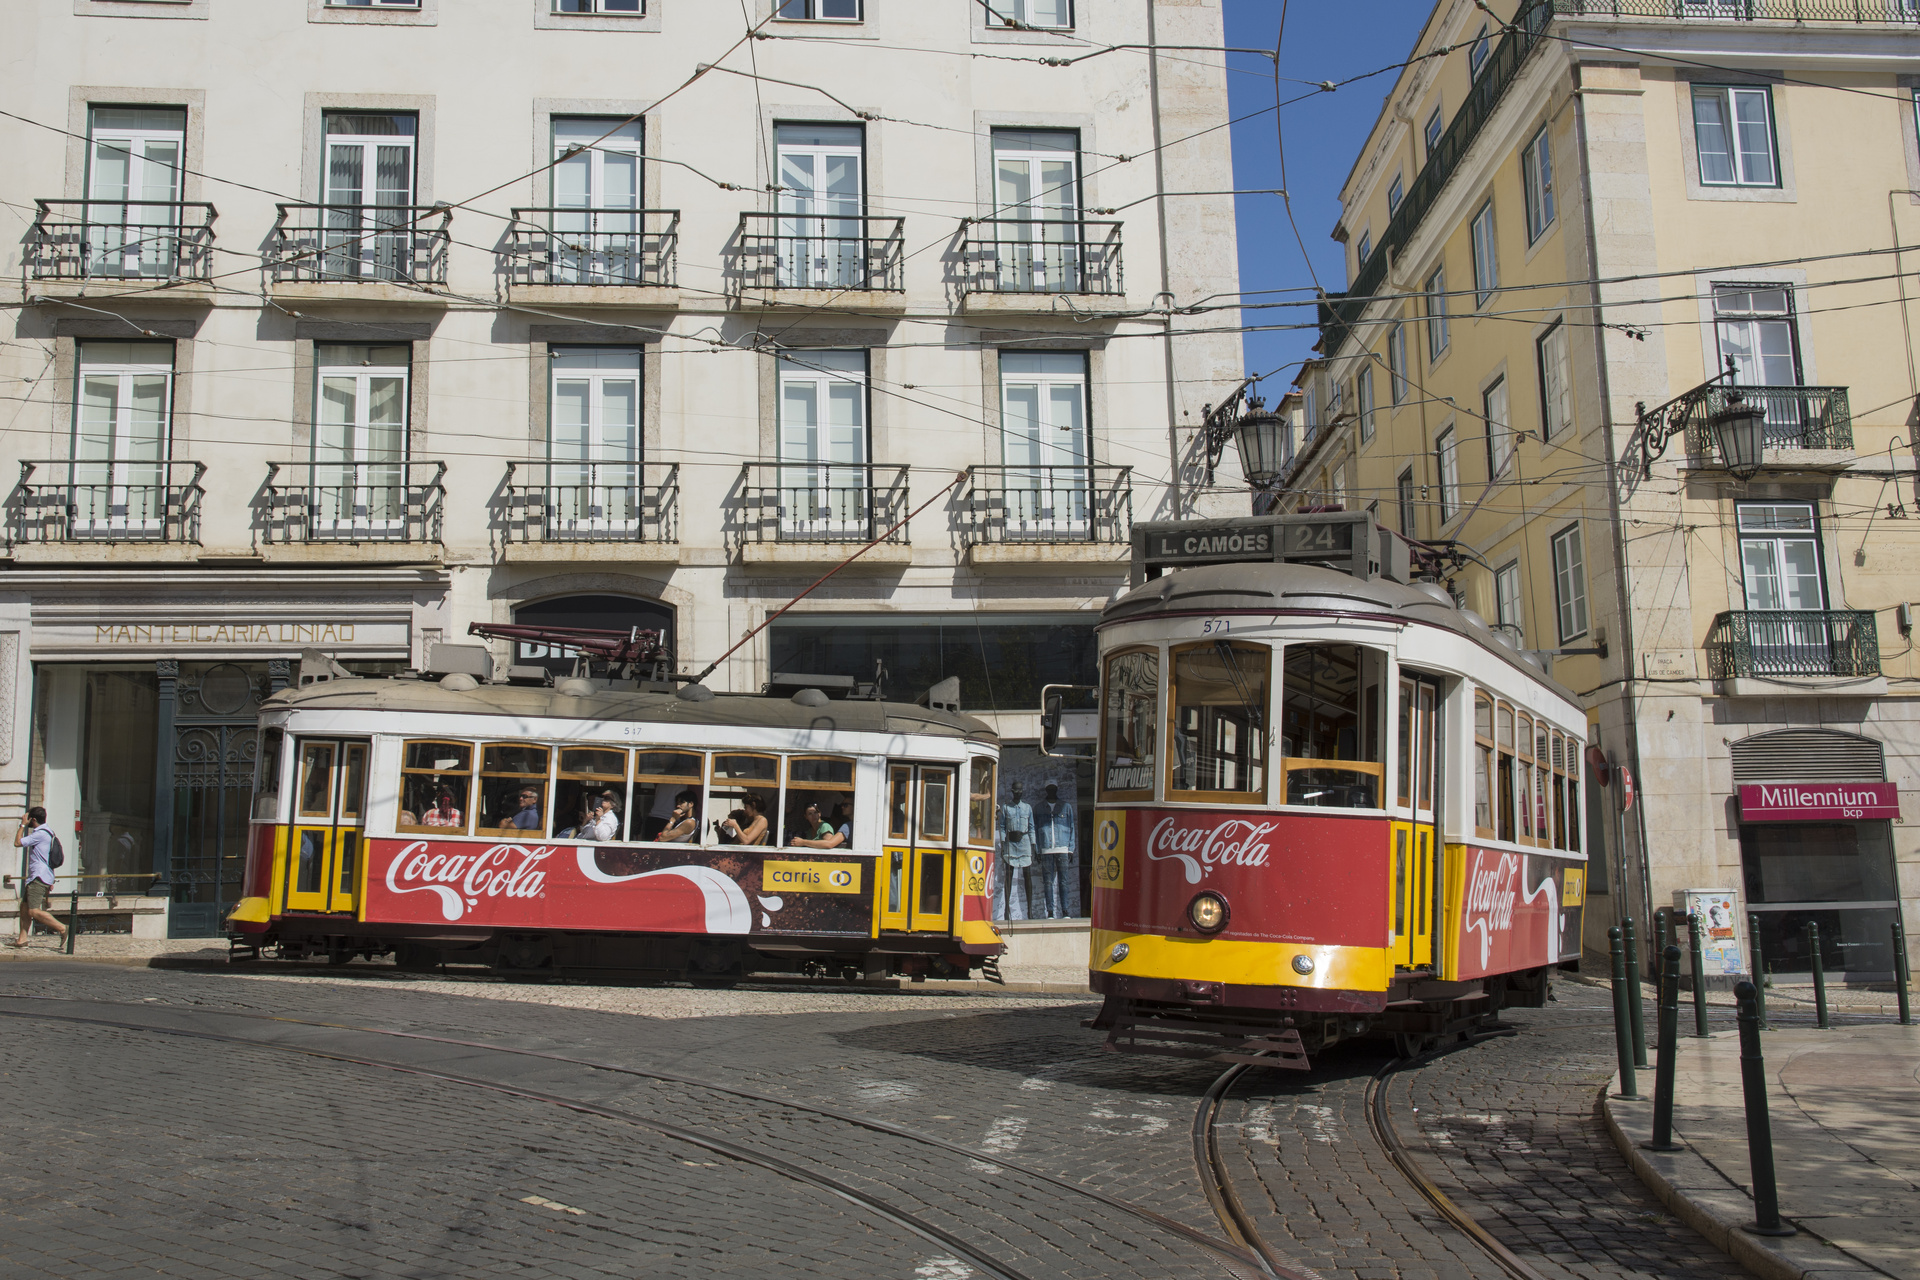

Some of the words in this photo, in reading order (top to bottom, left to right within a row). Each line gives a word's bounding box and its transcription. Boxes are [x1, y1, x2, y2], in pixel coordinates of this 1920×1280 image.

[1161, 538, 1177, 554] L.
[1295, 525, 1336, 551] 24
[95, 624, 272, 643] MANTEIGARIA
[1203, 620, 1231, 633] 571
[1759, 784, 1878, 807] Millennium
[1843, 807, 1863, 819] bcp
[1147, 817, 1279, 873] Coca-Cola
[386, 841, 557, 908] Coca-Cola
[772, 868, 820, 884] carris
[1466, 850, 1519, 945] Coca-Cola
